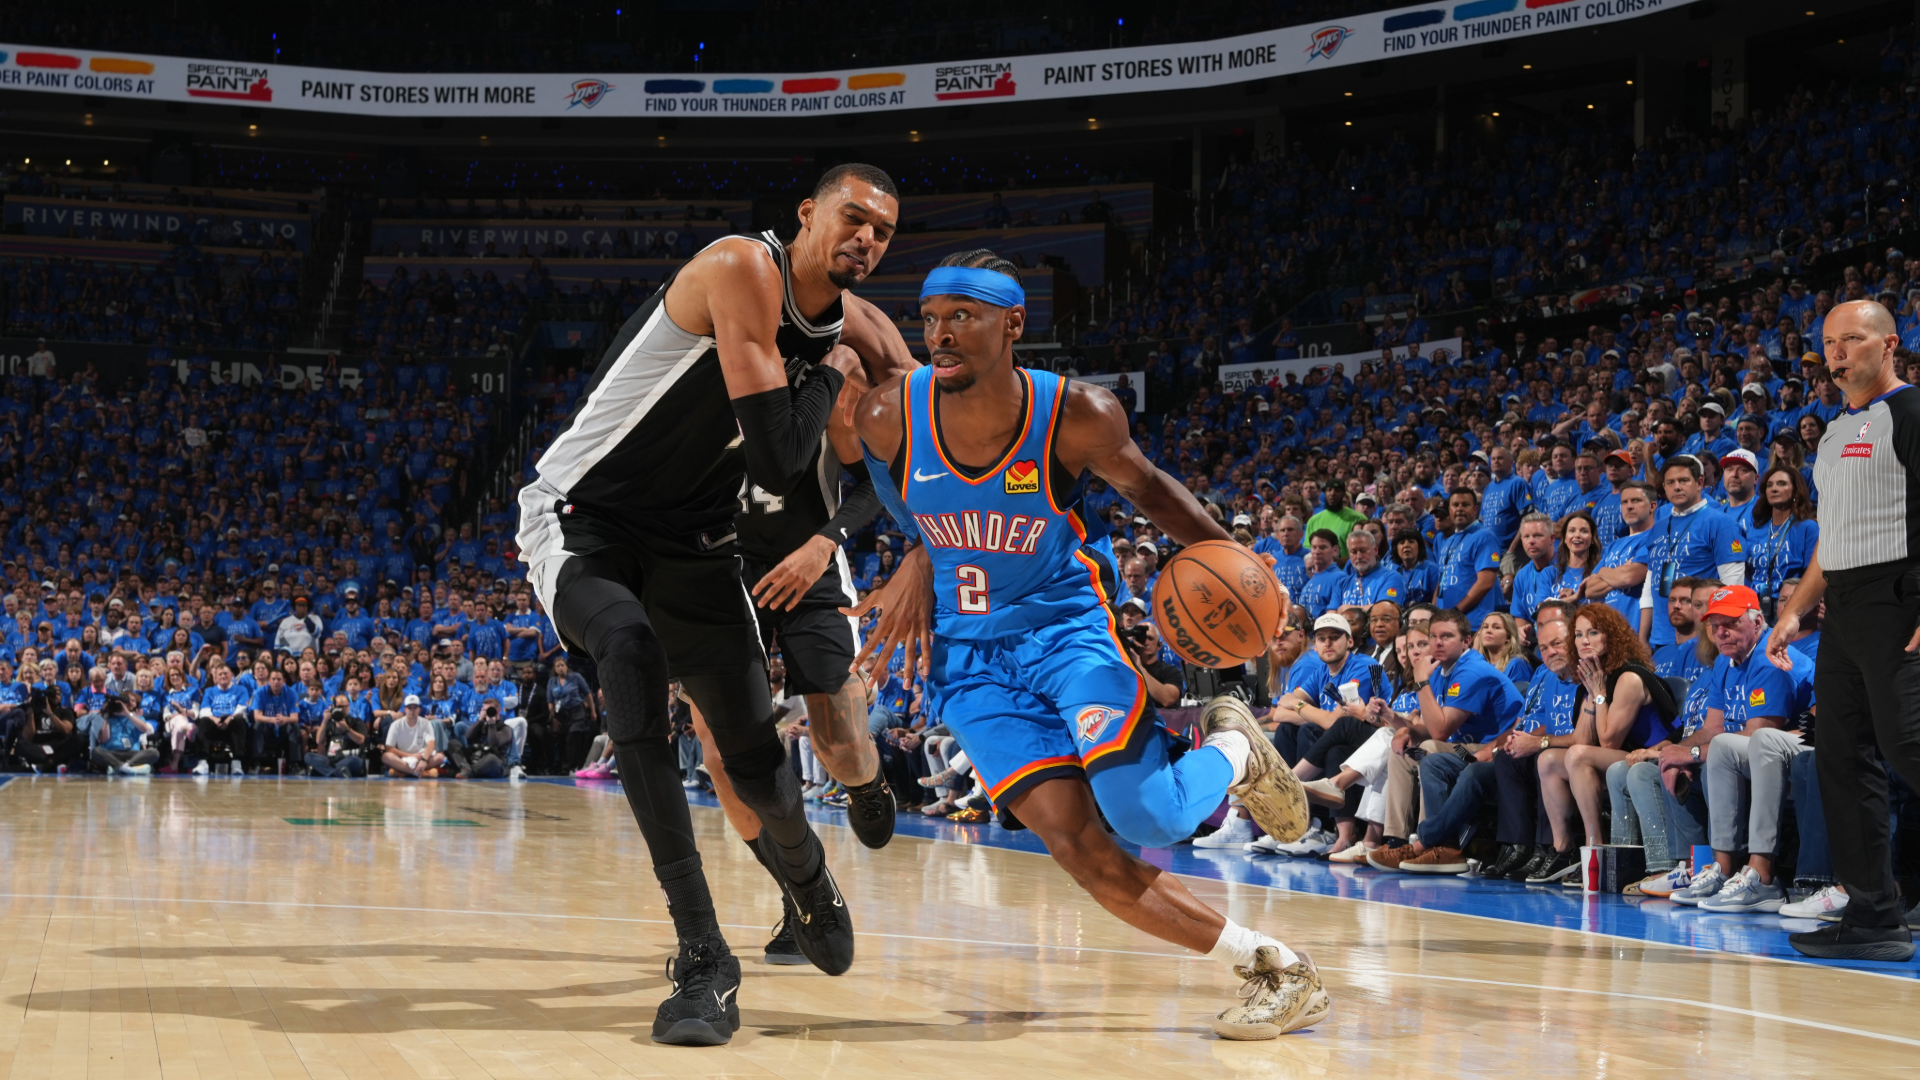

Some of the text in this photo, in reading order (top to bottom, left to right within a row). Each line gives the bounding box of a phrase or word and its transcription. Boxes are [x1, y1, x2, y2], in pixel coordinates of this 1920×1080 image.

[1383, 34, 1416, 53] FIND
[1420, 27, 1458, 46] YOUR
[1462, 14, 1532, 40] THUNDER
[1536, 6, 1581, 28] PAINT
[1585, 0, 1645, 20] COLORS
[187, 63, 268, 79] SPECTRUM
[935, 62, 1012, 78] SPECTRUM
[1044, 44, 1277, 86] PAINT STORES WITH MORE
[0, 69, 155, 94] ER PAINT COLORS AT
[187, 74, 253, 92] PAINT
[301, 80, 536, 104] PAINT STORES WITH MORE
[935, 74, 998, 93] PAINT
[645, 90, 906, 112] FIND YOUR THUNDER PAINT COLORS AT
[22, 206, 181, 232] RIVERWIND
[421, 228, 679, 246] RIVERWIND CAINO
[471, 371, 505, 393] 101
[1224, 368, 1280, 380] SPECUM
[1842, 446, 1871, 455] Emirates
[911, 510, 1049, 555] THUNDER
[956, 564, 990, 615] 2
[1080, 711, 1103, 740] OKC
